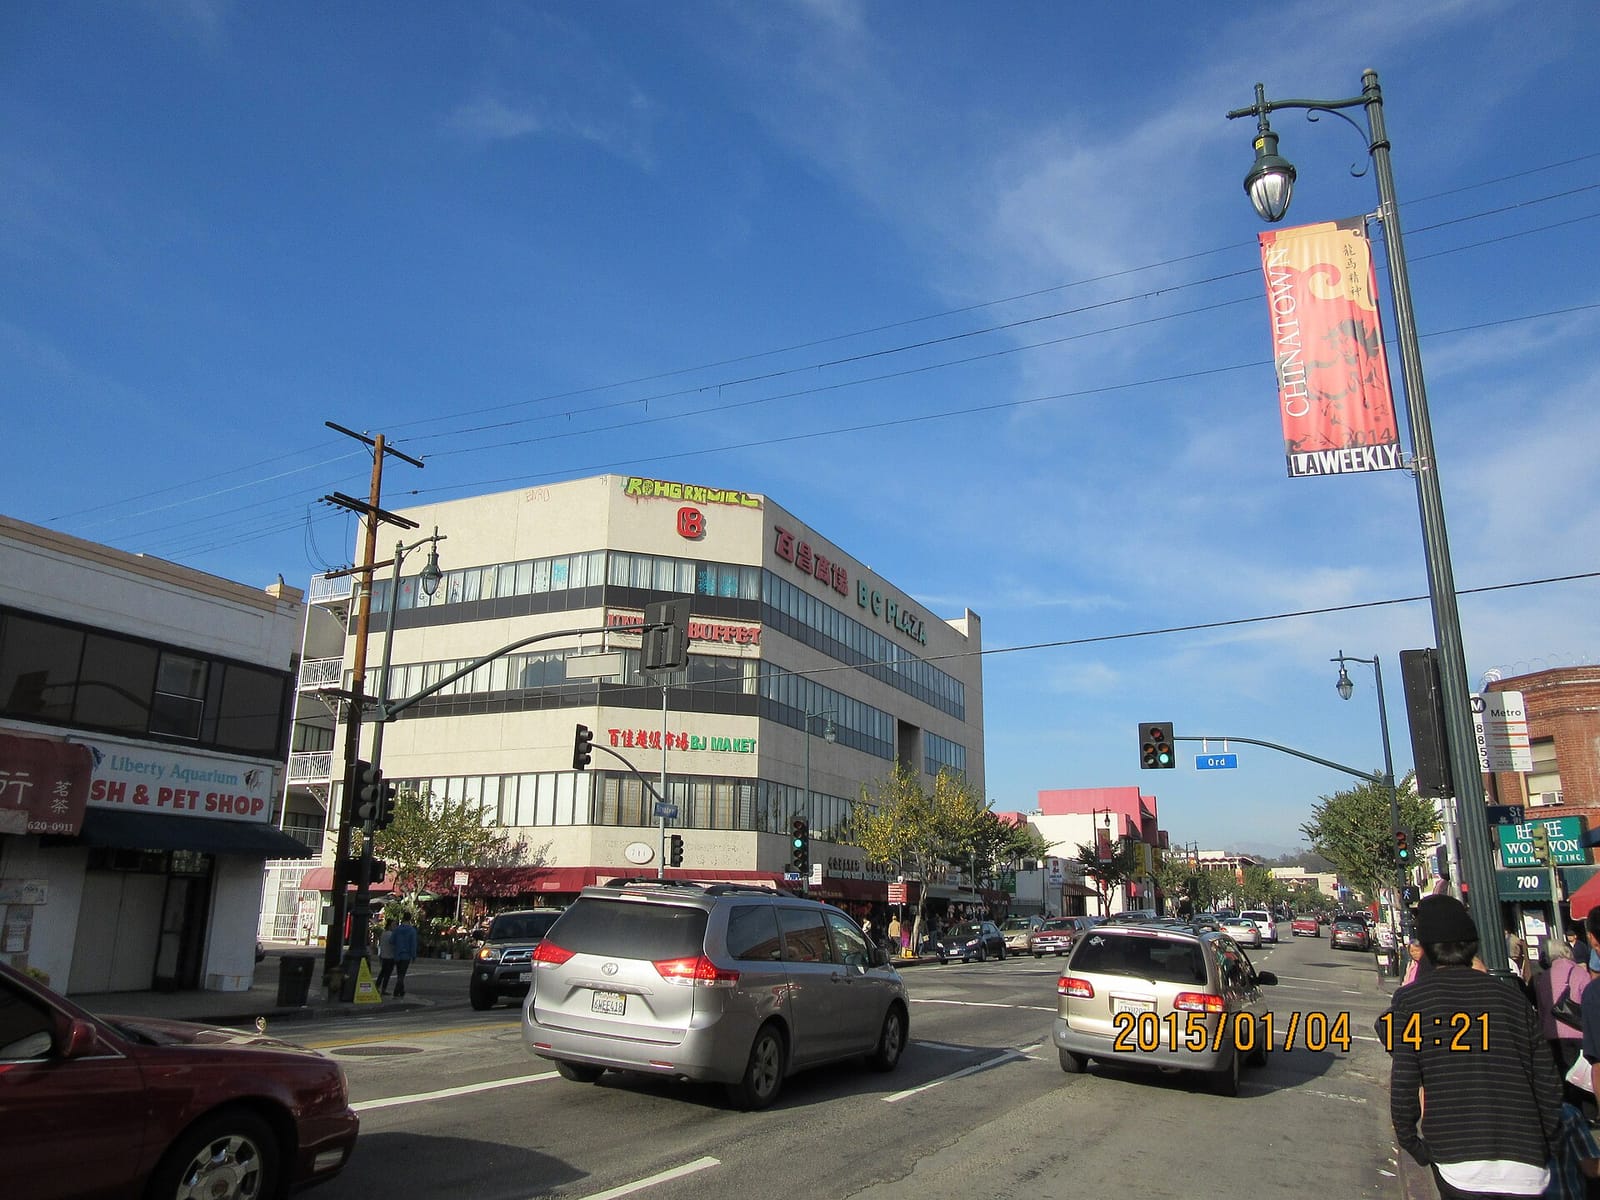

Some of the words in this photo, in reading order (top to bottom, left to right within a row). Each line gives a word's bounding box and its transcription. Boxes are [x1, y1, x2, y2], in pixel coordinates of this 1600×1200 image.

[1266, 248, 1310, 418] CHINATOWN
[885, 597, 928, 648] PLAZA
[687, 622, 762, 645] BUFFET
[1491, 709, 1522, 717] Metro
[690, 735, 708, 750] BJ
[1208, 758, 1225, 767] Ord
[110, 755, 166, 780] Liberty
[169, 763, 239, 786] Aquarium
[132, 784, 149, 806] &
[157, 787, 200, 810] PET
[205, 792, 264, 816] SHOP
[1509, 806, 1521, 816] St
[27, 820, 74, 832] 620-0911
[1517, 876, 1539, 889] 700
